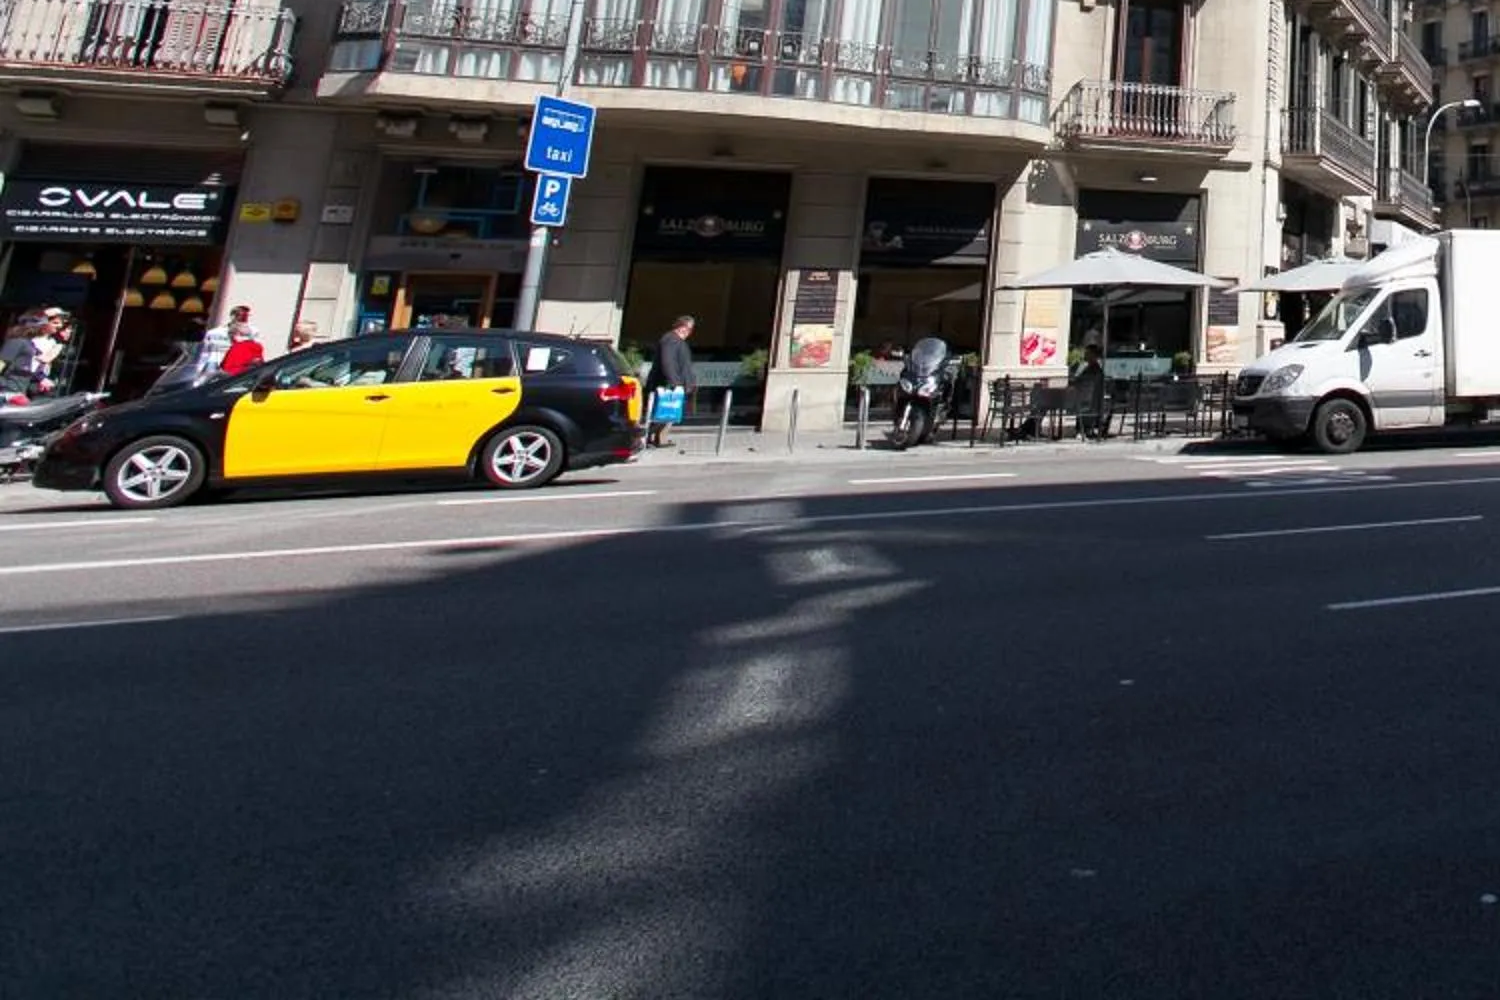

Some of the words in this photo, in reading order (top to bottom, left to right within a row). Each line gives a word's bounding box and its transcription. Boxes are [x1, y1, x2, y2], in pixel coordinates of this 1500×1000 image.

[546, 145, 574, 163] taxi
[38, 186, 208, 210] OVALE
[544, 179, 561, 199] P
